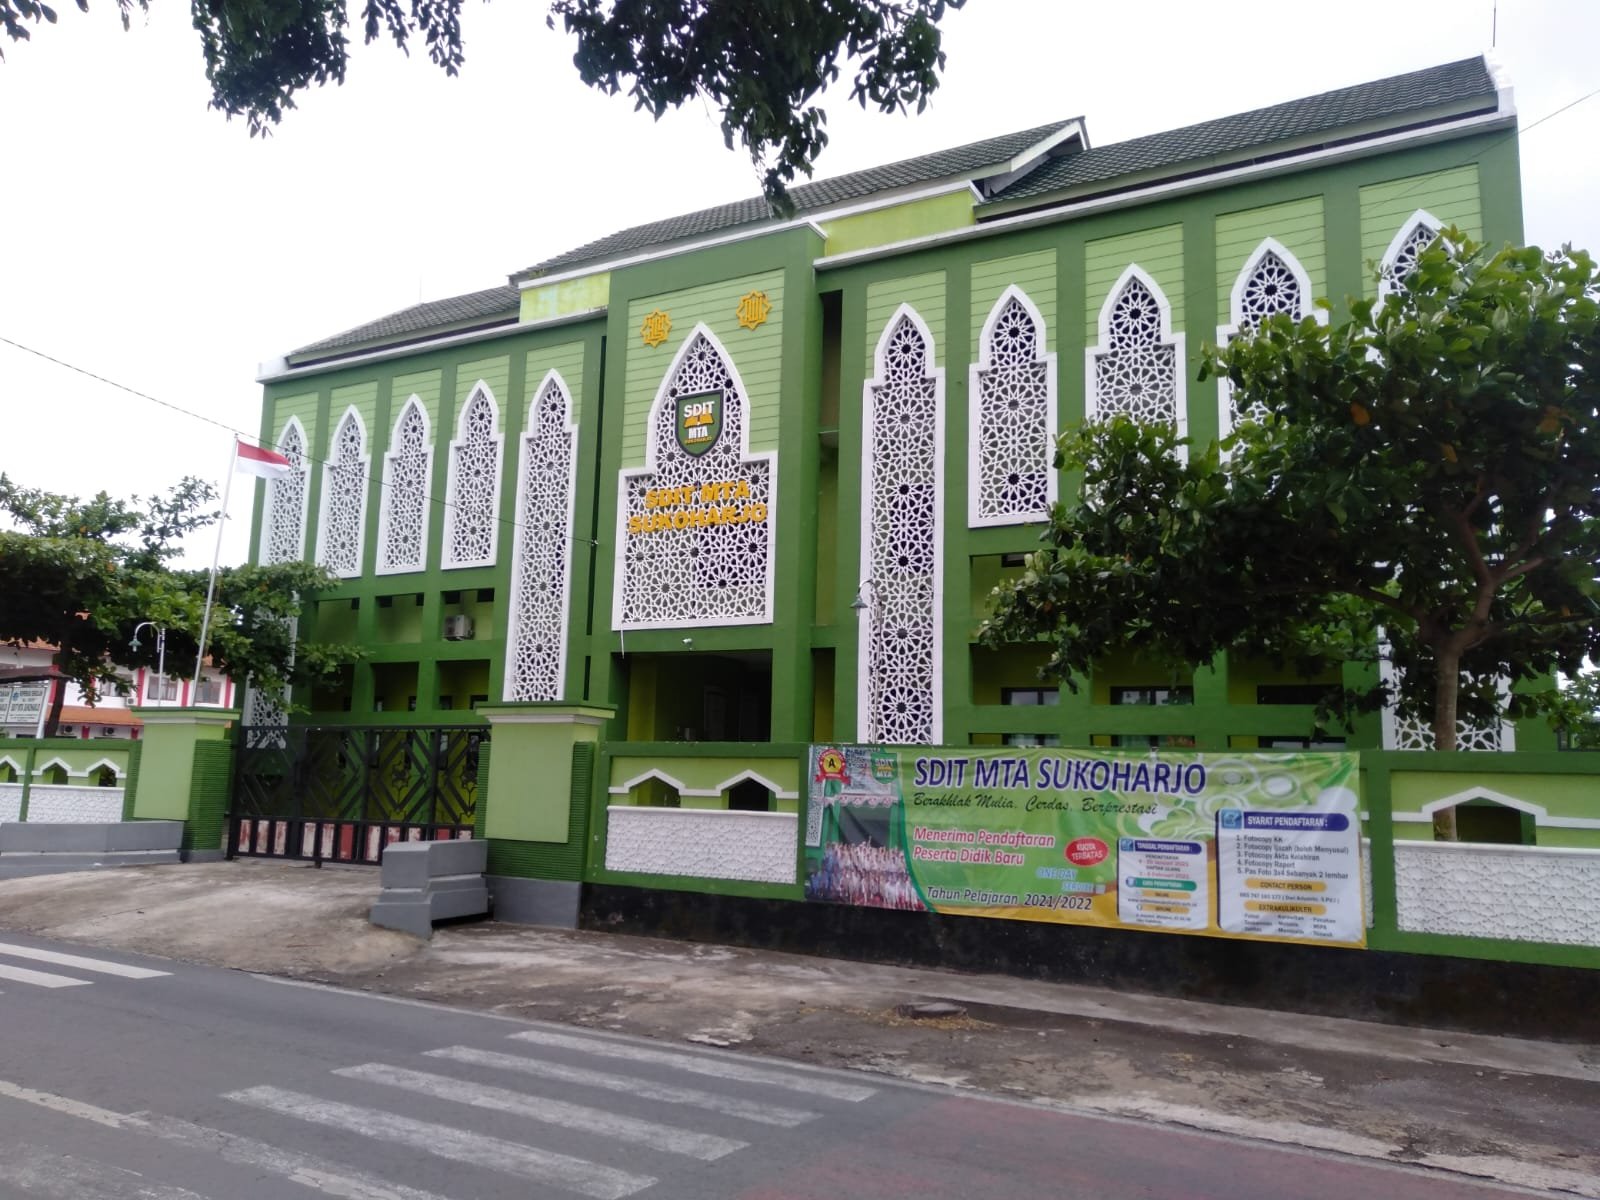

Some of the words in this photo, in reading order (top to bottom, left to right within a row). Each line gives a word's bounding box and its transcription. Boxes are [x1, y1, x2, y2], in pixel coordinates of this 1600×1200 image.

[684, 401, 715, 418] SDIT
[688, 425, 708, 439] MTA
[644, 483, 695, 509] SDIT
[700, 479, 751, 506] MTA
[628, 503, 768, 535] SUKOHARJO
[828, 758, 836, 769] A
[875, 758, 894, 767] SDIT
[914, 757, 969, 787] SDIT
[974, 758, 1030, 789] MTA
[1037, 758, 1206, 795] SUKOHARJO
[913, 792, 971, 808] Berakhlak
[1081, 797, 1158, 816] Berprestasi
[1247, 815, 1273, 825] SYARAT
[914, 827, 974, 843] Menerima
[977, 830, 1055, 848] Pendaftaran
[1244, 835, 1272, 844] Fotocopy
[1244, 843, 1272, 852] Fotocopy
[914, 846, 955, 862] Peserta
[957, 848, 992, 863] Didik
[995, 850, 1024, 865] Baru
[1244, 851, 1273, 860] Fotocopy
[1244, 859, 1273, 868] Fotocopy
[1258, 868, 1272, 876] Foto
[1260, 881, 1286, 889] CONTACT
[927, 887, 961, 901] Tahun
[963, 888, 1017, 906] Pelajaran
[1023, 893, 1092, 911] 2021/2022
